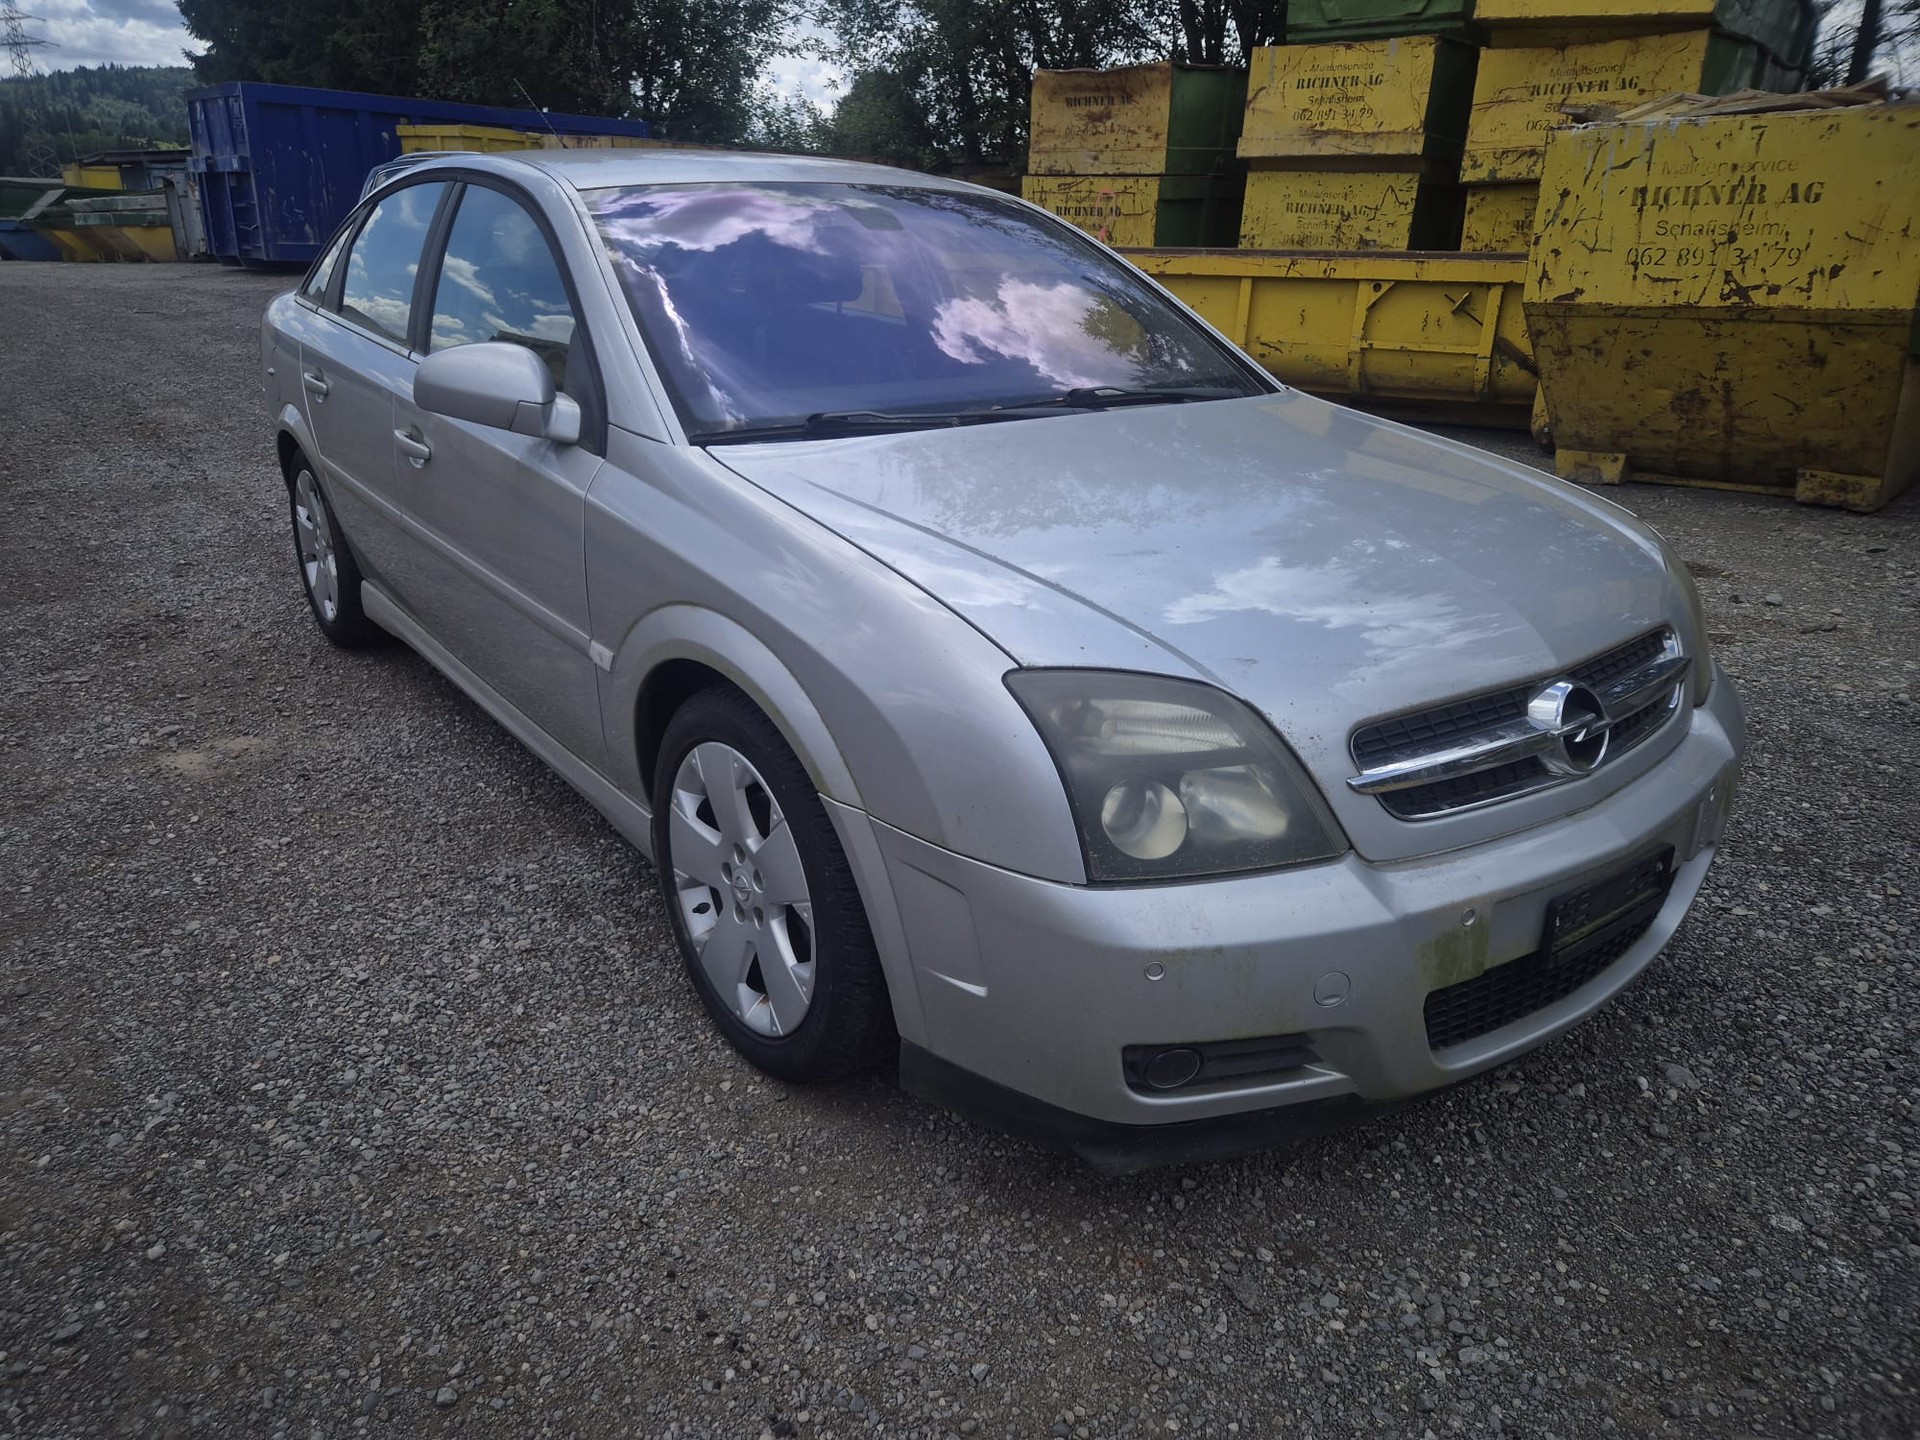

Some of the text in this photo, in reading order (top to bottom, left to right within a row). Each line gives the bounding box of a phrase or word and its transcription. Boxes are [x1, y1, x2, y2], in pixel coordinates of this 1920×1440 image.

[1296, 74, 1385, 90] RICHNER AG
[1529, 75, 1640, 98] RICHNER AG
[1065, 95, 1115, 107] RICHNER
[1293, 109, 1313, 121] 062
[1630, 181, 1826, 207] RICHNER AG
[1056, 205, 1104, 217] RICHNER
[1285, 202, 1345, 215] RICHNER
[1627, 247, 1802, 267] 062 891 34 79
